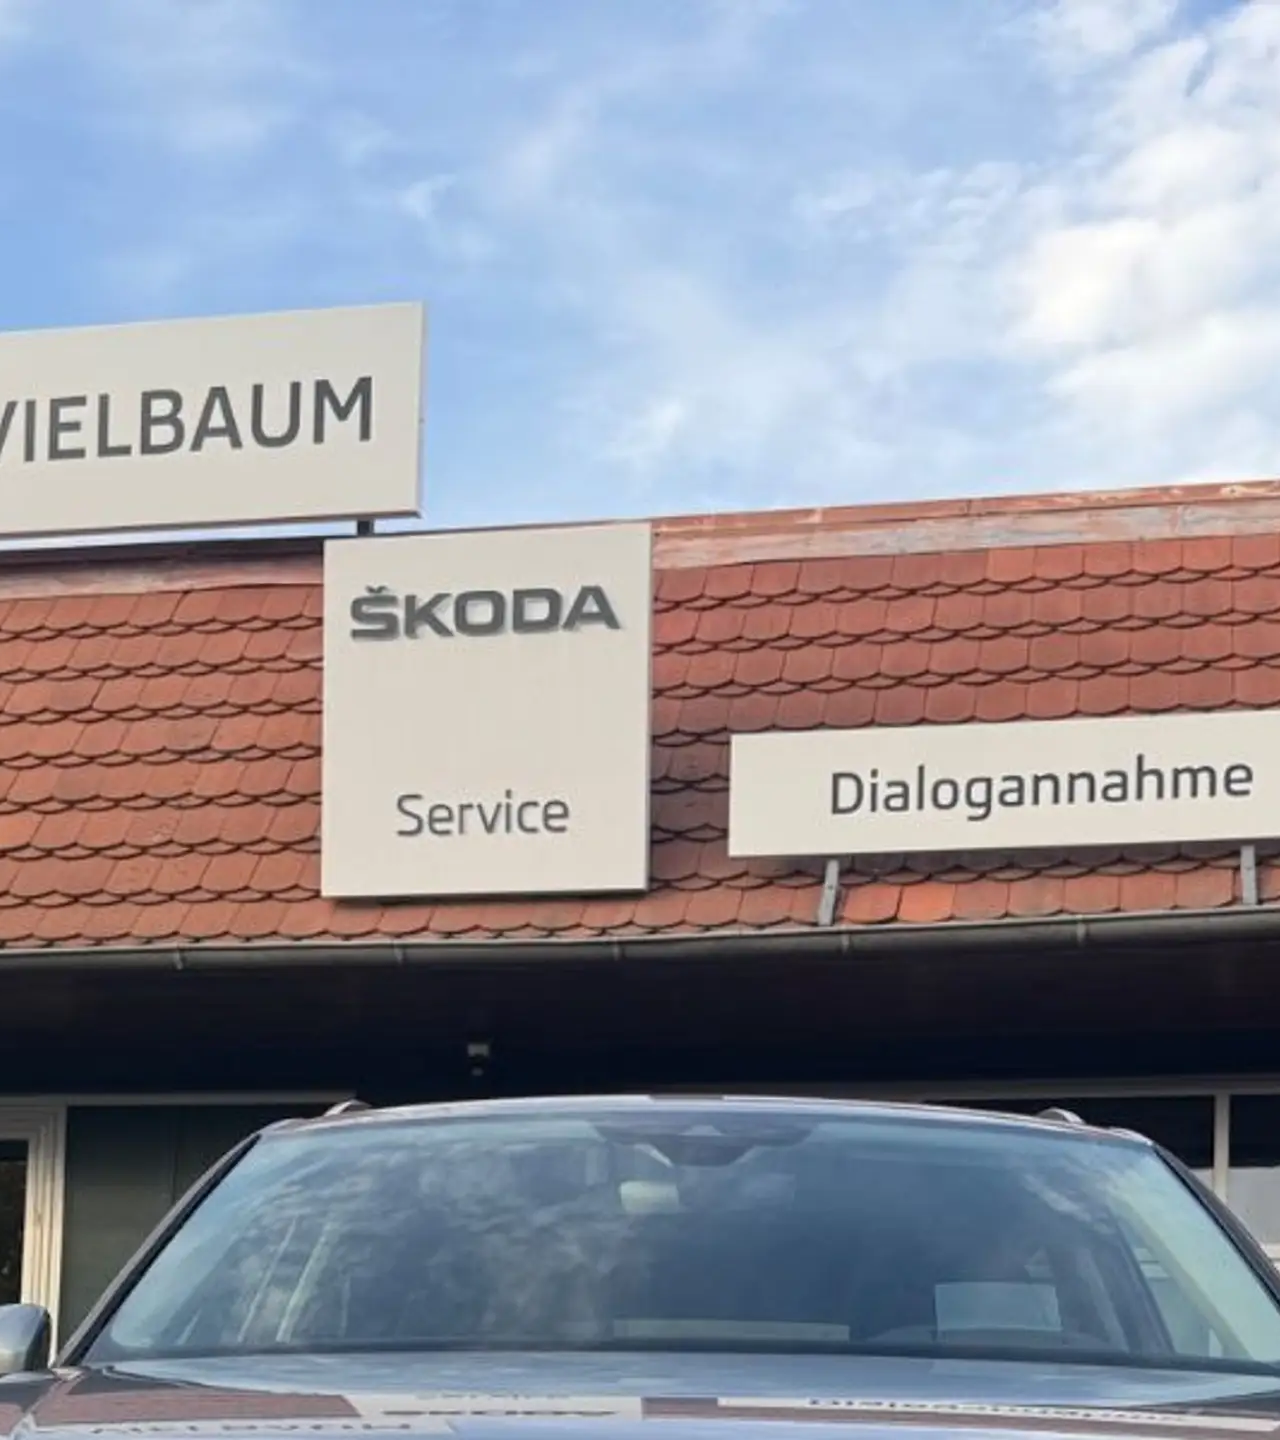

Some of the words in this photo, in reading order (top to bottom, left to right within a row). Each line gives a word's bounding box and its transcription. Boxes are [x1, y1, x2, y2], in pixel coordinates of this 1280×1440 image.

[349, 585, 623, 640] ŠKODA
[395, 788, 571, 838] Service
[830, 753, 1254, 822] Dialogannahme
